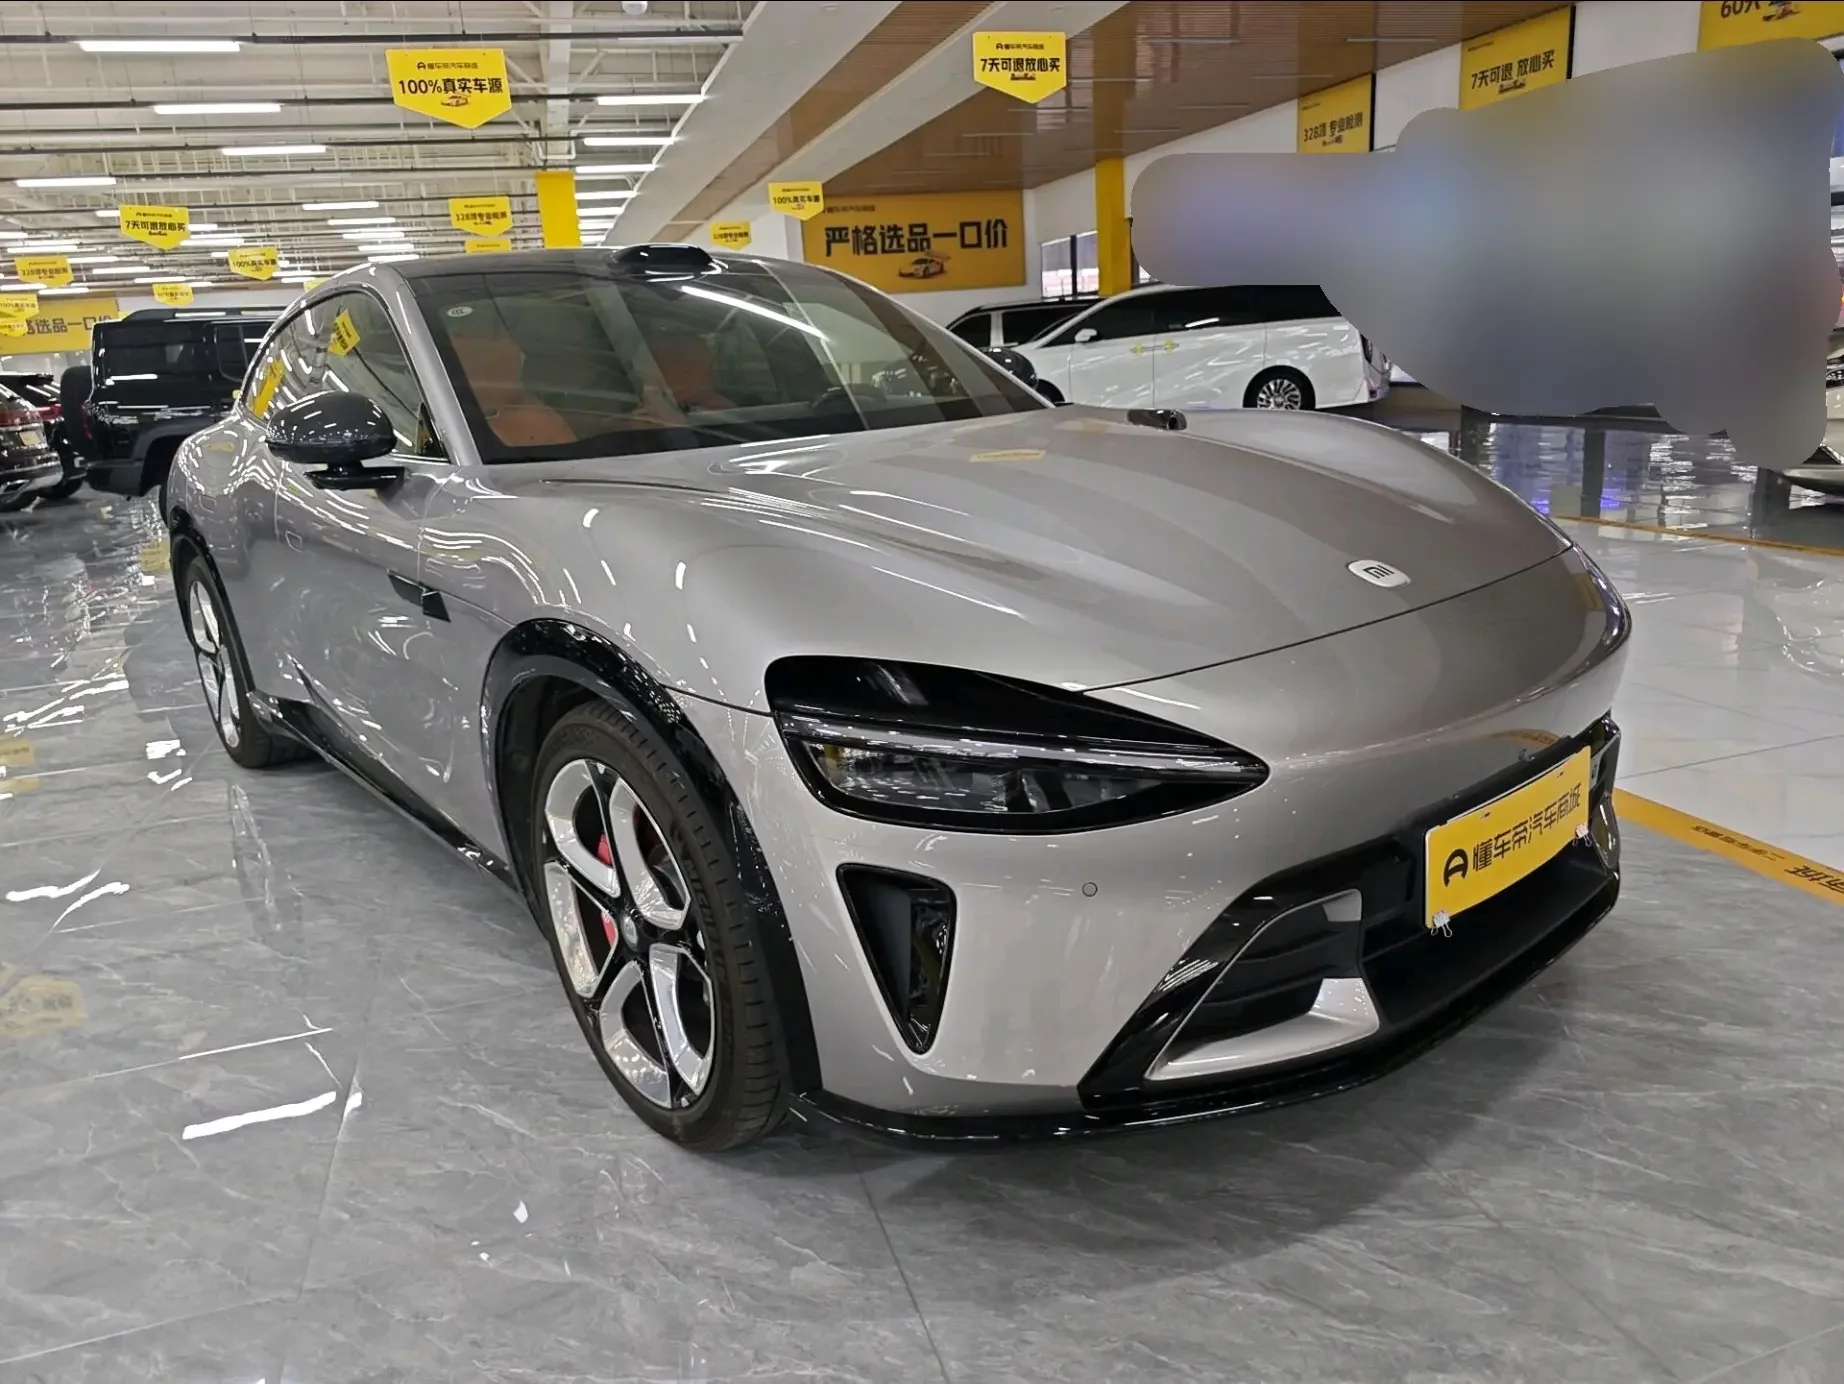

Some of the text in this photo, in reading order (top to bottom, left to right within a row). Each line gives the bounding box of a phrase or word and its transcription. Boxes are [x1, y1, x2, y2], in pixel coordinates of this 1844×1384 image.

[980, 57, 1060, 73] 7天可退放心买
[1516, 49, 1555, 78] 放心买
[398, 77, 503, 94] 100%真实车源
[824, 218, 1008, 258] 严格选品一口价
[1473, 783, 1582, 872] 懂车帝汽车商城
